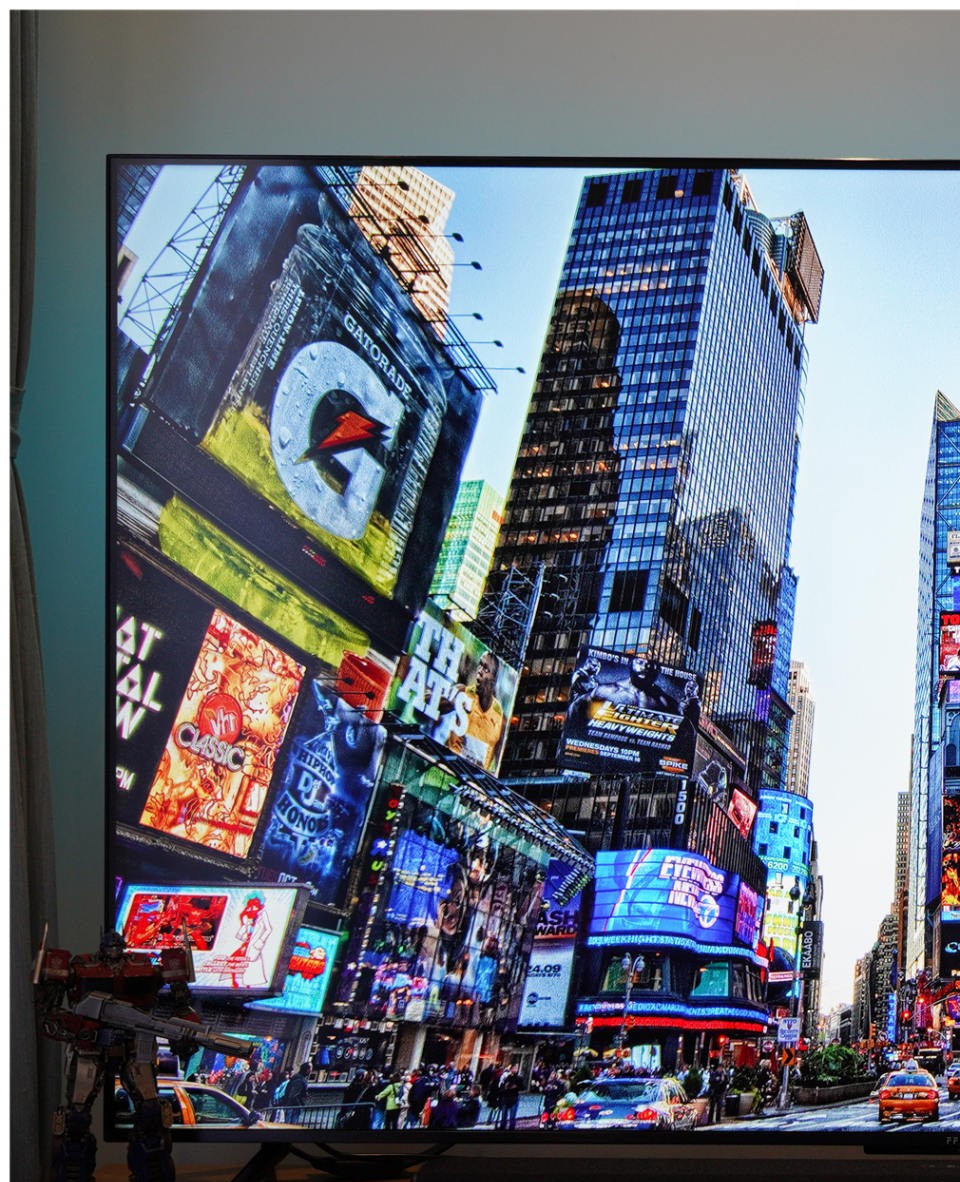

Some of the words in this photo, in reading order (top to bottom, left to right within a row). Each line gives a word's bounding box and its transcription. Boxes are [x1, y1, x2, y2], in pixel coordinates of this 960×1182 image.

[342, 311, 413, 399] GATORADE
[116, 605, 163, 662] AT
[588, 648, 620, 663] KIMBO'S
[621, 656, 629, 665] IN
[660, 665, 674, 677] THE
[675, 669, 697, 681] HOUSE
[175, 721, 246, 772] CLASSIC
[566, 738, 619, 753] WEDNESDAYS
[588, 719, 676, 742] HEAVYWEIGHTS
[659, 759, 688, 770] SPIKE
[674, 779, 687, 825] 1500
[768, 862, 788, 870] 6200
[802, 930, 814, 969] EKAABO
